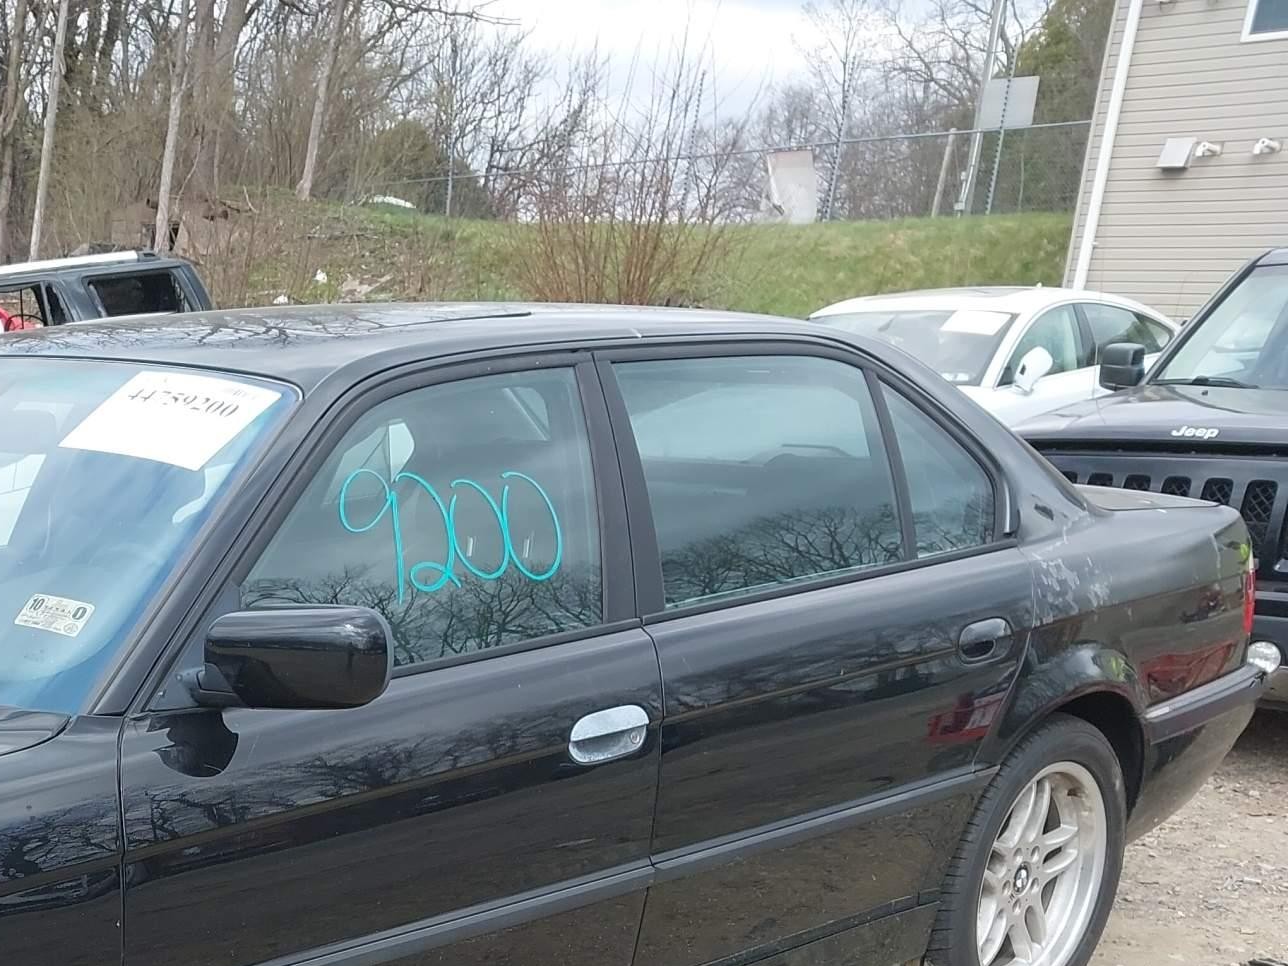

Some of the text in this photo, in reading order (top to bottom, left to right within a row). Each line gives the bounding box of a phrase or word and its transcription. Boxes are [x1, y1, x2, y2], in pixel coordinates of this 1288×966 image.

[1171, 425, 1219, 439] Jeep
[339, 468, 562, 605] 9200
[29, 597, 45, 611] 10
